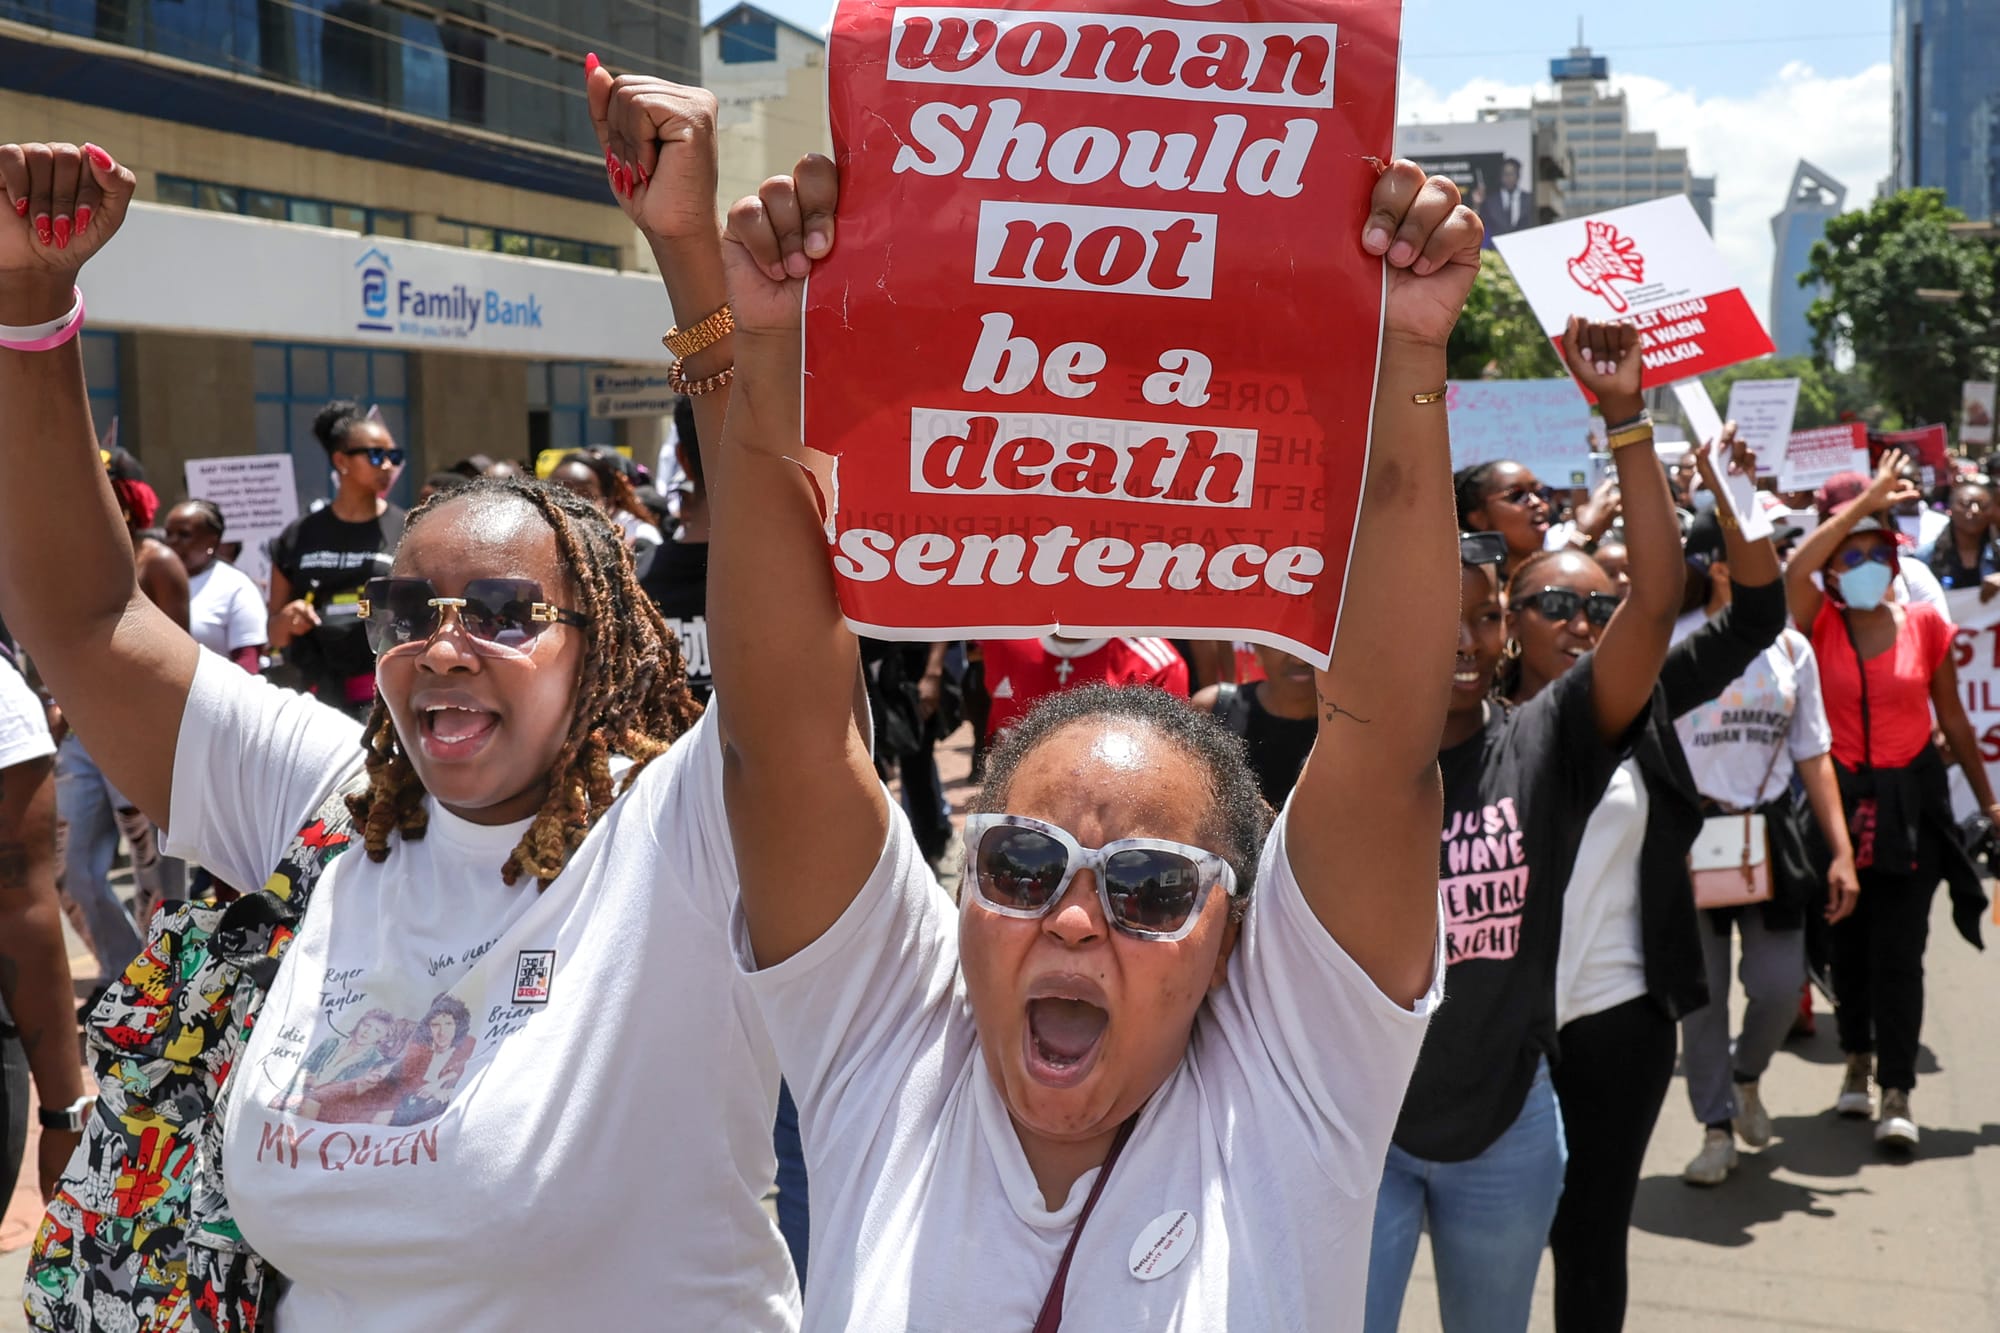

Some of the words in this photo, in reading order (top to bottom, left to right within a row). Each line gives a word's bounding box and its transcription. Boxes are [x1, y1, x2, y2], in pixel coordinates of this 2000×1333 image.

[894, 16, 1330, 97] woman
[891, 97, 1319, 198] Should
[987, 218, 1203, 291] not
[1631, 311, 1660, 330] LET
[1659, 298, 1708, 322] WAHU
[1652, 318, 1706, 344] WAENI
[962, 312, 1107, 399] be
[1141, 348, 1213, 408] a
[1641, 341, 1704, 369] MALKIA
[921, 415, 1244, 504] death
[835, 525, 1325, 596] sentence
[1442, 797, 1518, 842] JUST
[1448, 831, 1525, 874] HAVE
[319, 989, 368, 1011] Taylor
[323, 968, 365, 990] Roger
[488, 1005, 535, 1023] Brian
[256, 1121, 315, 1169] MY
[318, 1124, 440, 1171] QUEEN
